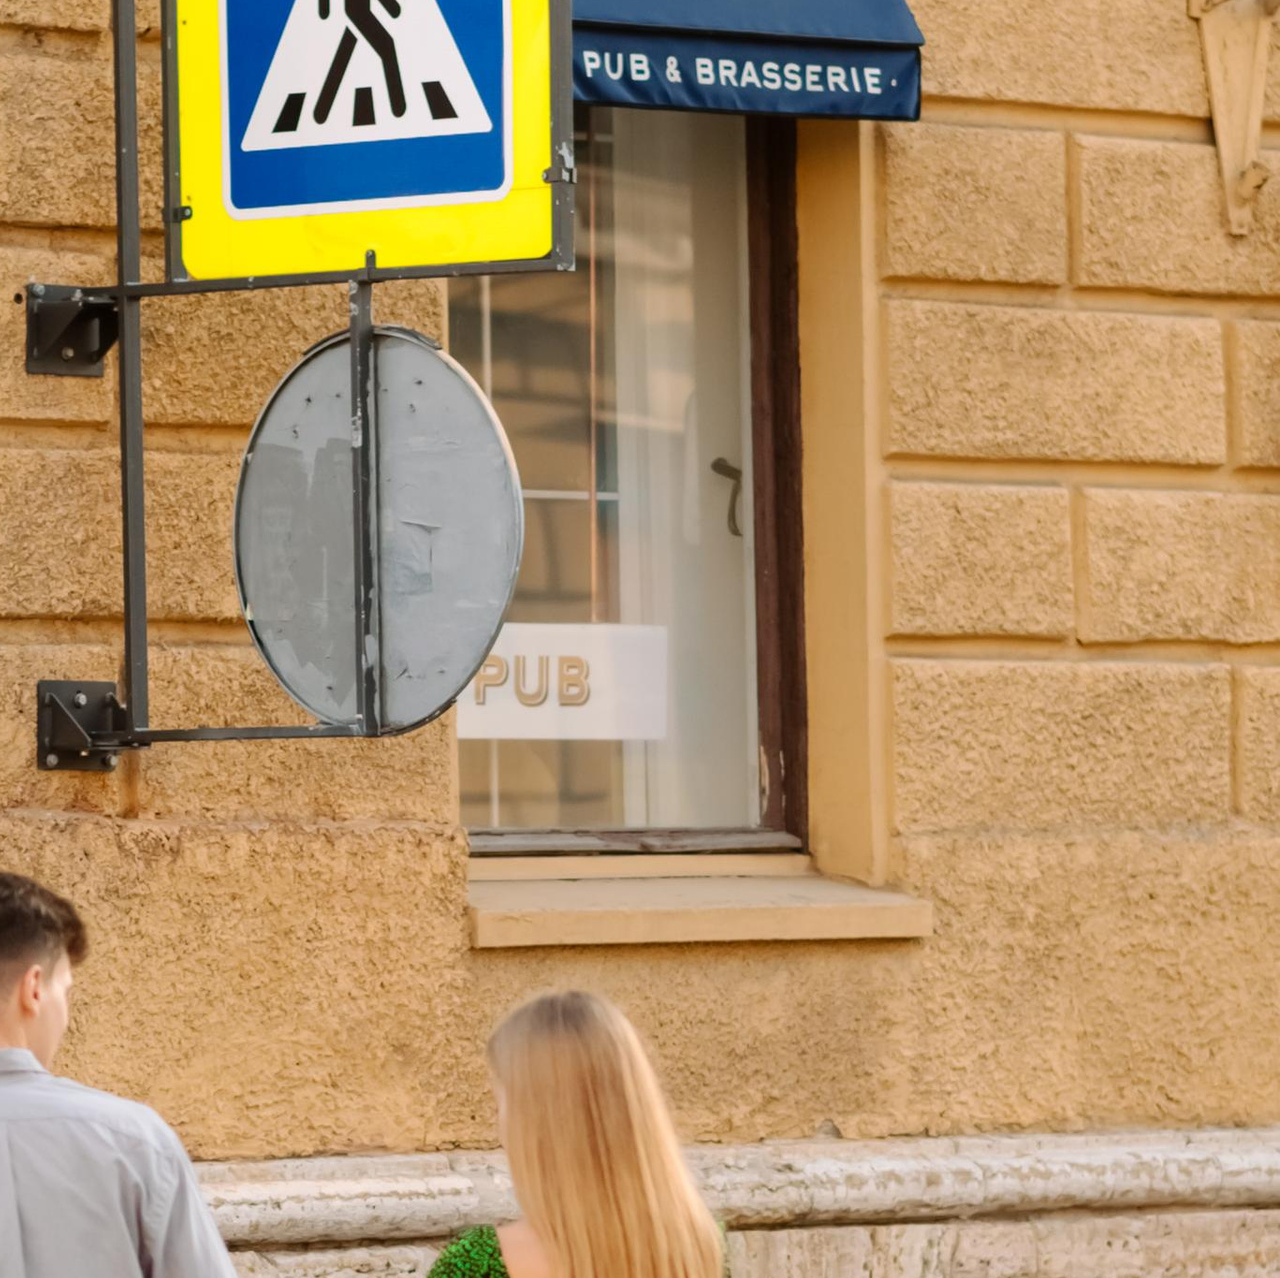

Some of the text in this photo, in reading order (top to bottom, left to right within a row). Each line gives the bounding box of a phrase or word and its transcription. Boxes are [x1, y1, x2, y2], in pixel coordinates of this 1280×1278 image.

[582, 50, 883, 95] PUB & BRASSERIE
[474, 654, 590, 707] PUB
